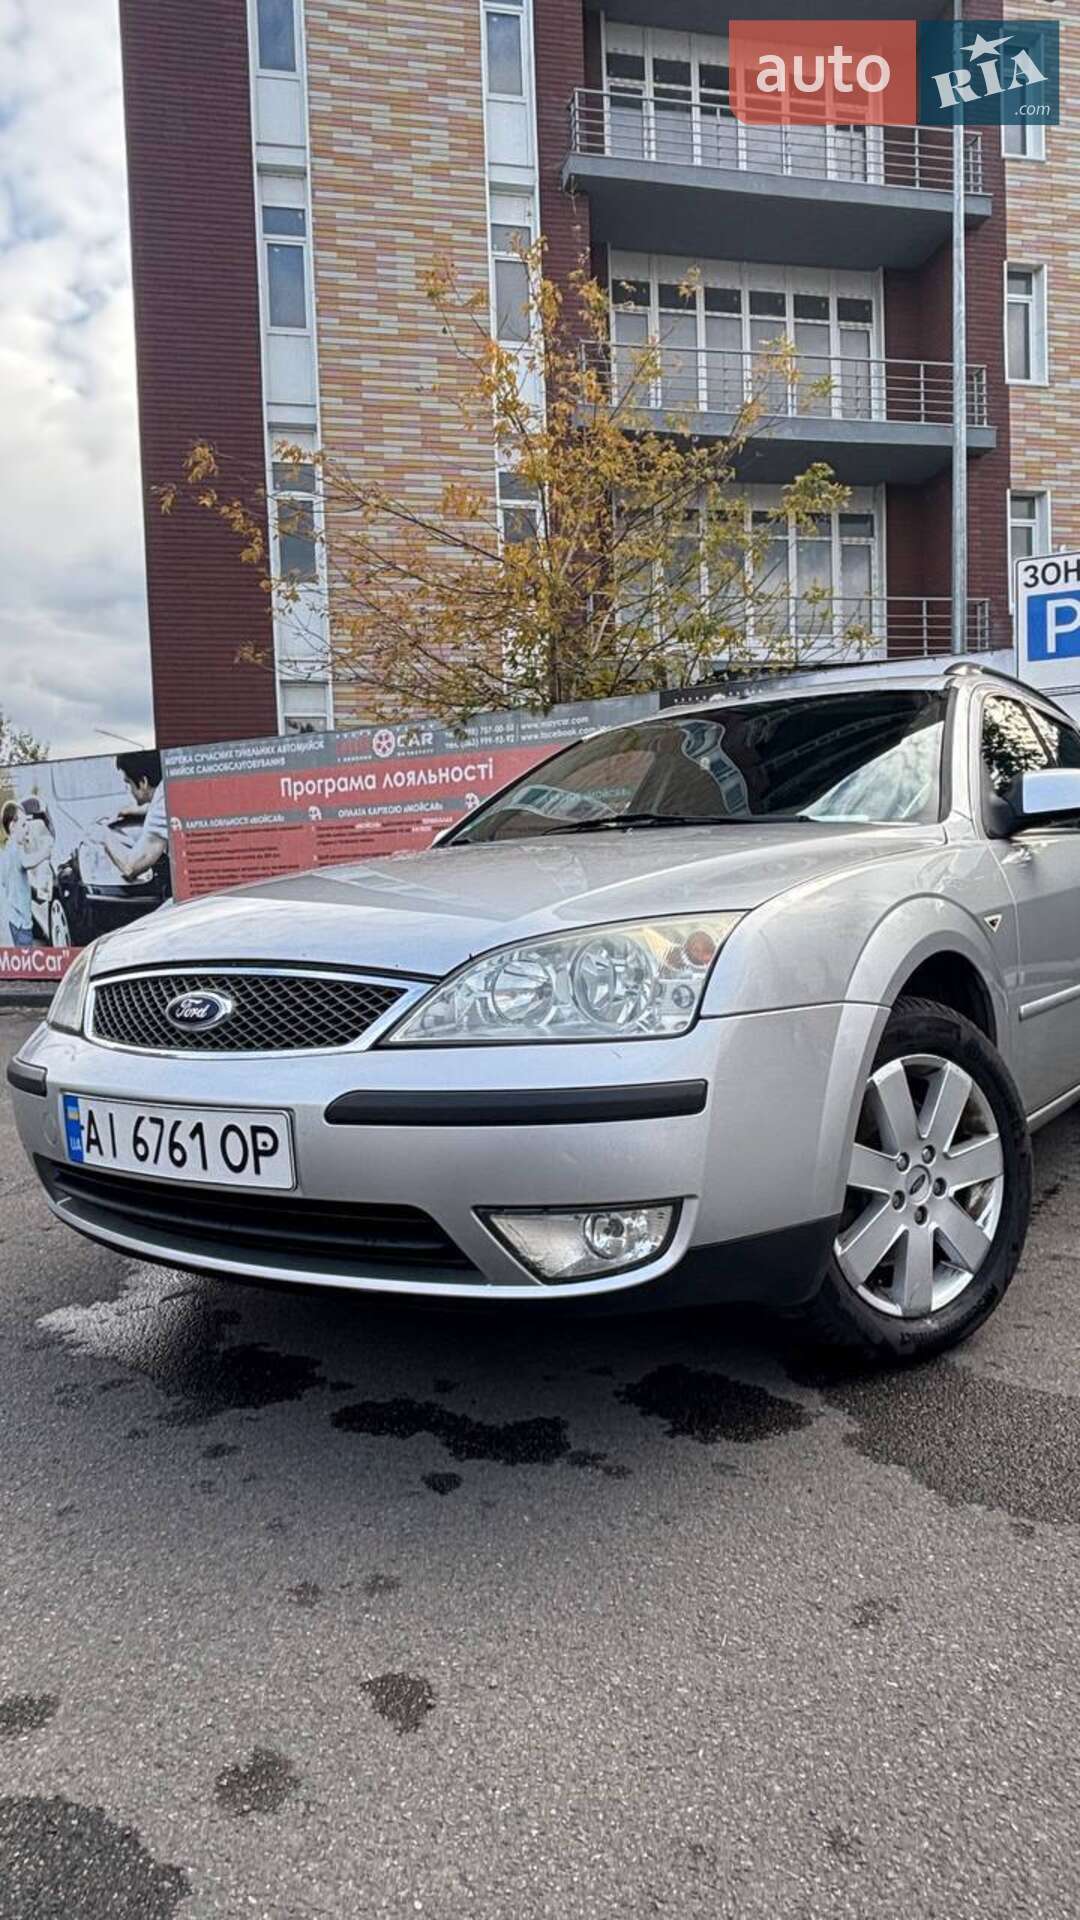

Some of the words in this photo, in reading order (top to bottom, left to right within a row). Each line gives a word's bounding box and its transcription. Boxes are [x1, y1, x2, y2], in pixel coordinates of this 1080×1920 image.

[1046, 597, 1080, 654] P
[281, 773, 377, 801] Програма
[383, 757, 494, 790] лояльності
[175, 998, 211, 1019] Ford
[86, 1109, 117, 1159] AI
[132, 1115, 208, 1171] 6761
[220, 1123, 279, 1176] OP
